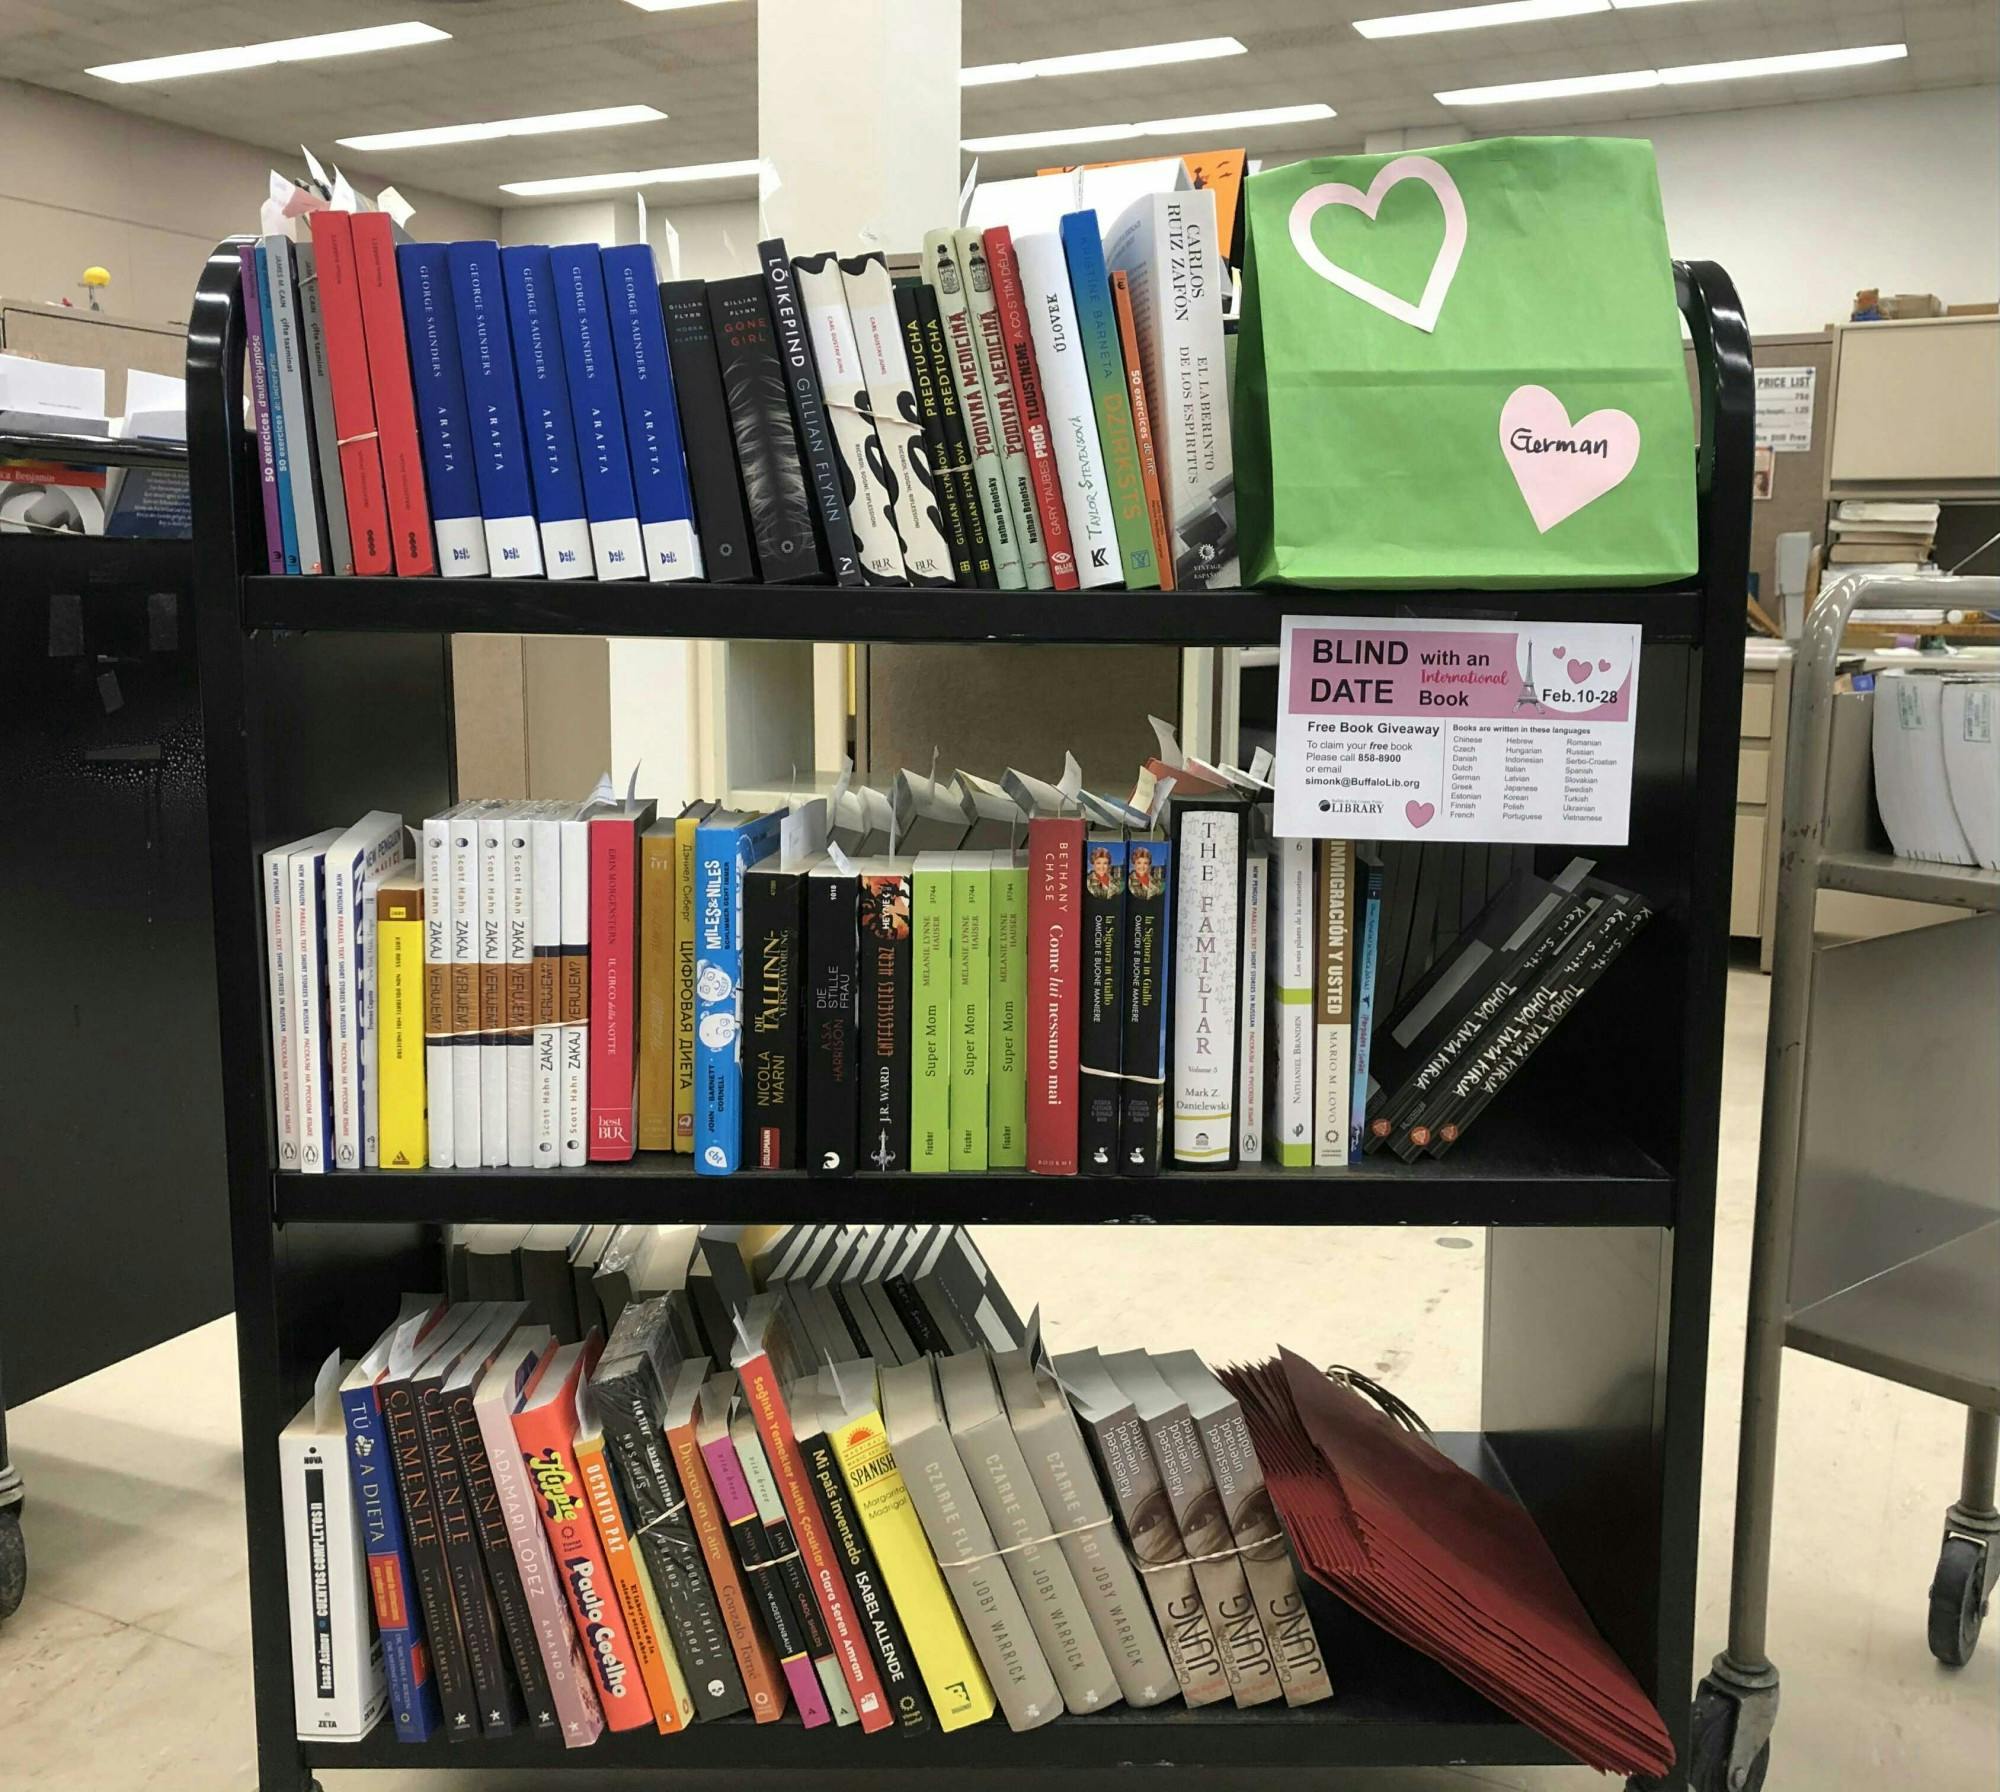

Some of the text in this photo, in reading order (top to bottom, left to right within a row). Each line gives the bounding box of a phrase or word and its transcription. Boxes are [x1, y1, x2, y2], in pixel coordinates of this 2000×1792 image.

[1167, 202, 1191, 321] RUIZ ZAFÓN
[1186, 224, 1205, 298] CARLOS
[420, 266, 441, 377] GEORGE SAUNDERS
[725, 318, 767, 332] GONE
[731, 334, 766, 346] GIRL
[1047, 293, 1067, 353] ÚLOVEK
[769, 258, 840, 521] LÕIKEPIND GILLIAN FLYNN
[907, 320, 937, 417] PREDTUCHA
[1758, 377, 1810, 388] PRICE LIST
[253, 335, 275, 482] 50 exercices d'autohypnose
[1180, 347, 1198, 484] DE LOS ESPÍRITUS
[1197, 357, 1215, 470] EL LABERINTO
[438, 406, 454, 472] ARAFTA
[1028, 424, 1049, 459] PROČ
[1510, 428, 1608, 459] German
[1040, 460, 1055, 500] TAUBES
[1048, 503, 1061, 536] GARY
[1085, 492, 1102, 541] TAYLOR
[1313, 639, 1490, 666] BLIND with an
[1311, 678, 1469, 706] DATE Book
[1421, 669, 1509, 685] International
[1542, 689, 1618, 703] Feb.10-28
[1308, 722, 1440, 737] Free Book Giveaway
[1320, 741, 1344, 749] claim
[1347, 743, 1366, 751] your
[1369, 742, 1388, 750] free
[1391, 742, 1412, 750] book
[1506, 747, 1542, 755] Hungarian
[1552, 727, 1590, 735] languages
[1306, 753, 1337, 761] Please
[1358, 754, 1401, 762] 858-8900
[1305, 778, 1420, 789] simonk@BuffaloLib.org
[1332, 804, 1384, 813] LIBRARY
[1503, 813, 1542, 821] Portuguese
[431, 855, 439, 882] Scott
[1045, 854, 1054, 902] CHASE
[1059, 842, 1068, 912] BETHANY
[431, 889, 439, 914] Hahn
[704, 860, 722, 949] MILES&NILES
[429, 921, 442, 959] ZAKAJ
[1195, 822, 1216, 1055] THE FAMILIAR
[1327, 841, 1348, 1014] INMIGRACIÓN Y USTED
[1523, 906, 1585, 970] Keri Smith
[816, 988, 827, 1008] DIE
[828, 965, 838, 1008] STILLE
[840, 974, 849, 1008] FRAU
[680, 941, 694, 1089] ЦИФРОВАЯ ДИЕТА
[1048, 924, 1063, 1105] Come lui nessuno mai
[1413, 981, 1518, 1090] TUHOA TÄMÄ KIRJA
[926, 1005, 938, 1077] Super Mom
[1293, 1016, 1302, 1103] NATHANIEL BRANDEN
[757, 1051, 770, 1106] NICOLA
[772, 1055, 784, 1103] MARNI
[879, 1066, 892, 1124] J.R. WARD
[1185, 1088, 1209, 1097] Mark
[599, 1116, 621, 1126] best
[1176, 1101, 1230, 1111] Danielewski
[599, 1126, 628, 1142] BUR
[763, 1129, 771, 1166] GOLDMANN
[304, 1456, 323, 1464] NOVA
[351, 1402, 384, 1542] TÚ A DIETA
[390, 1391, 437, 1548] CLEMENTE
[850, 1453, 897, 1487] SPANISH
[530, 1451, 584, 1524] Hippie
[586, 1465, 624, 1553] OCTAVIO PAZ
[924, 1462, 959, 1523] CZARNE
[311, 1512, 328, 1571] COMPLETOS
[493, 1449, 545, 1599] ADAMARI LÓPEZ
[772, 1420, 793, 1478] Yemekler
[788, 1480, 806, 1515] Mutlu
[820, 1570, 835, 1601] Clara
[831, 1604, 848, 1637] Seren
[843, 1640, 864, 1682] Amram
[813, 1449, 904, 1683] Mi país inventado ISABEL ALLENDE
[316, 1571, 328, 1617] CUENTOS
[319, 1633, 331, 1664] Asimov
[573, 1561, 627, 1698] Paulo Coelho
[972, 1580, 1027, 1685] JOBY WARRICK
[1168, 1593, 1221, 1676] JUNG
[319, 1667, 332, 1690] Isaac
[318, 1720, 337, 1728] ZETA
